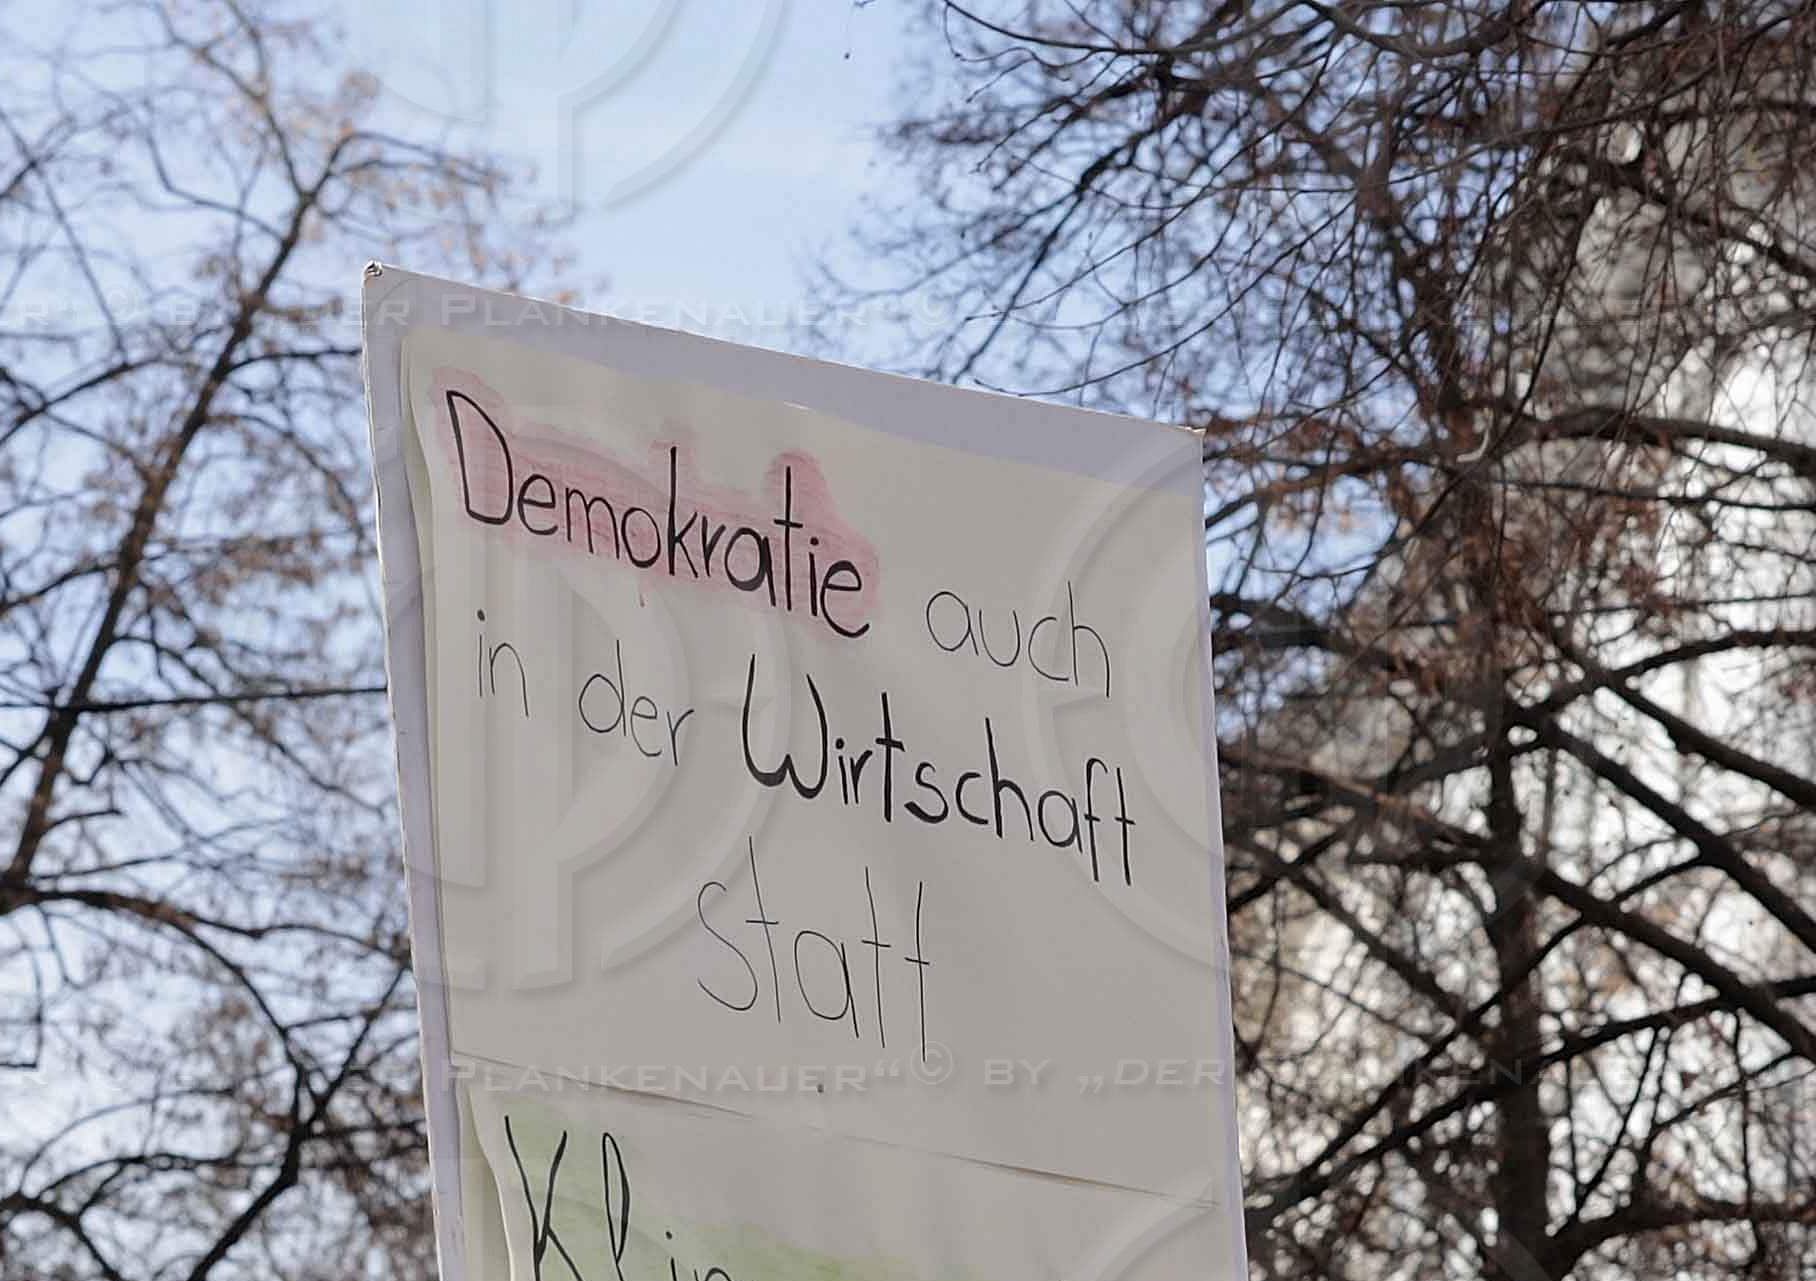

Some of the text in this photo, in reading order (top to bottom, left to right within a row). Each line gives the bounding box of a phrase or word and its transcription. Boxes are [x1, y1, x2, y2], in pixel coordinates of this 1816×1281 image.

[447, 389, 1110, 698] Demokratie auch
[476, 609, 1137, 886] in der Wirtschaft
